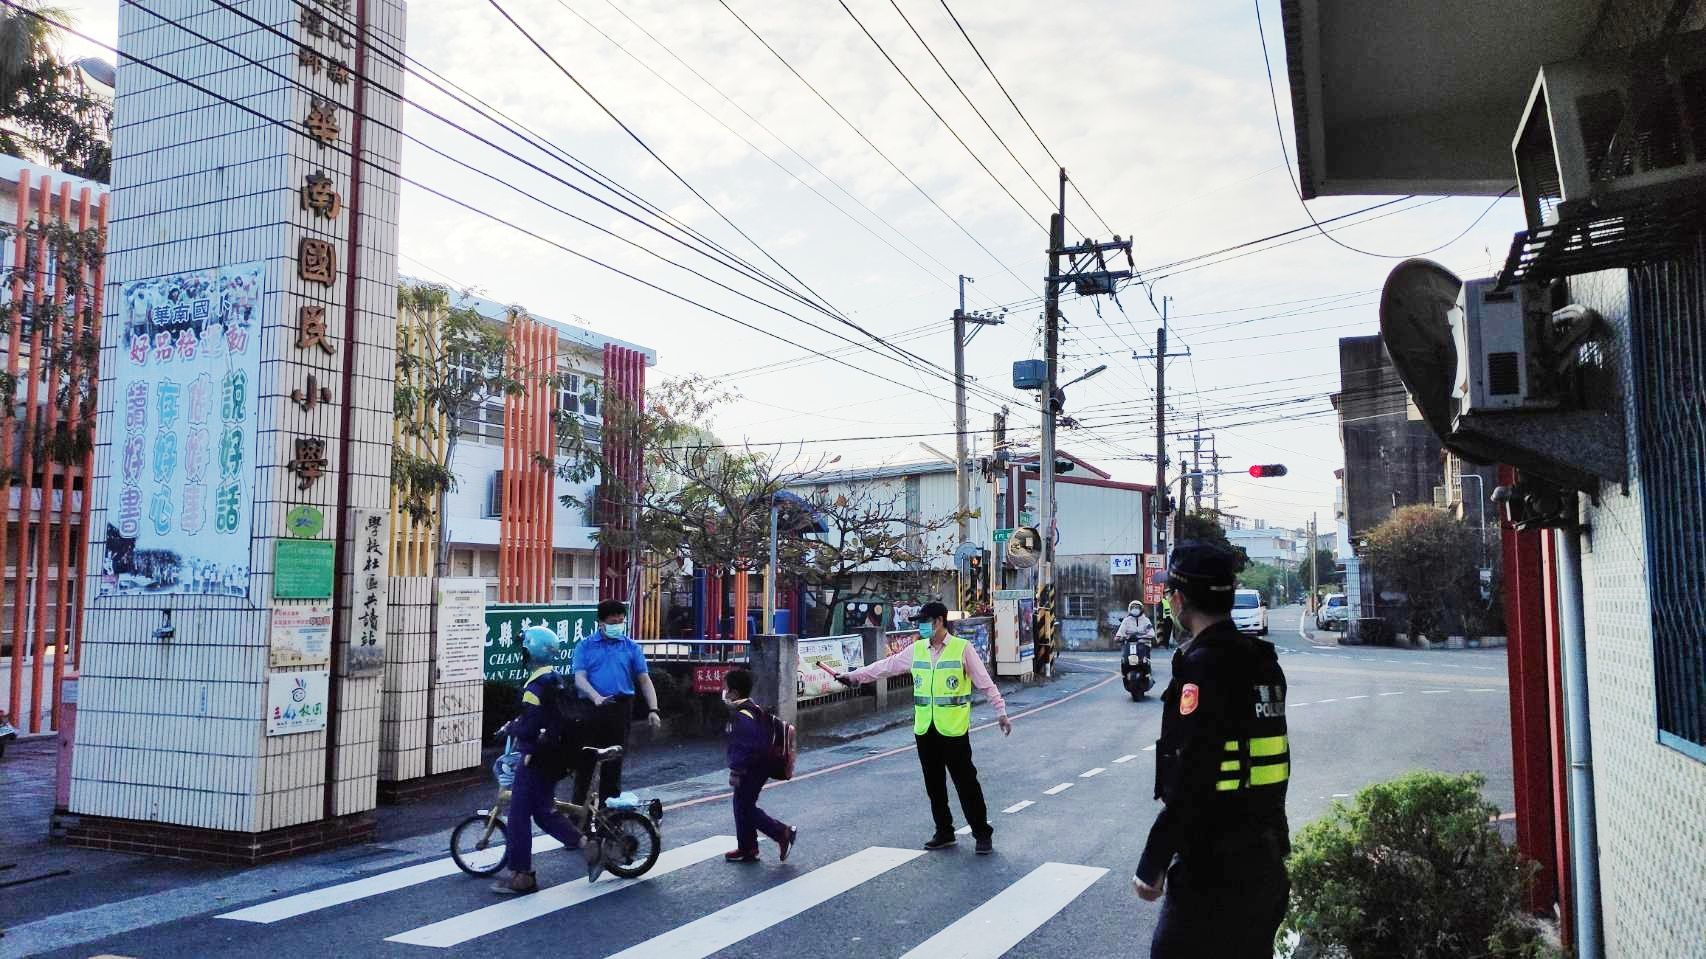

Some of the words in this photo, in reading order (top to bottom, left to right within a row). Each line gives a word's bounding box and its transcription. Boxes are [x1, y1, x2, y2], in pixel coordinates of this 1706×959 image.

[131, 323, 248, 363] 好品格運動
[289, 96, 342, 490] 華南國民小學
[121, 383, 148, 536] 讀好書
[153, 381, 179, 534] 存好心
[215, 372, 246, 532] 說好話
[358, 515, 383, 647] 學校社區共讀站
[273, 702, 323, 720] 三好校園
